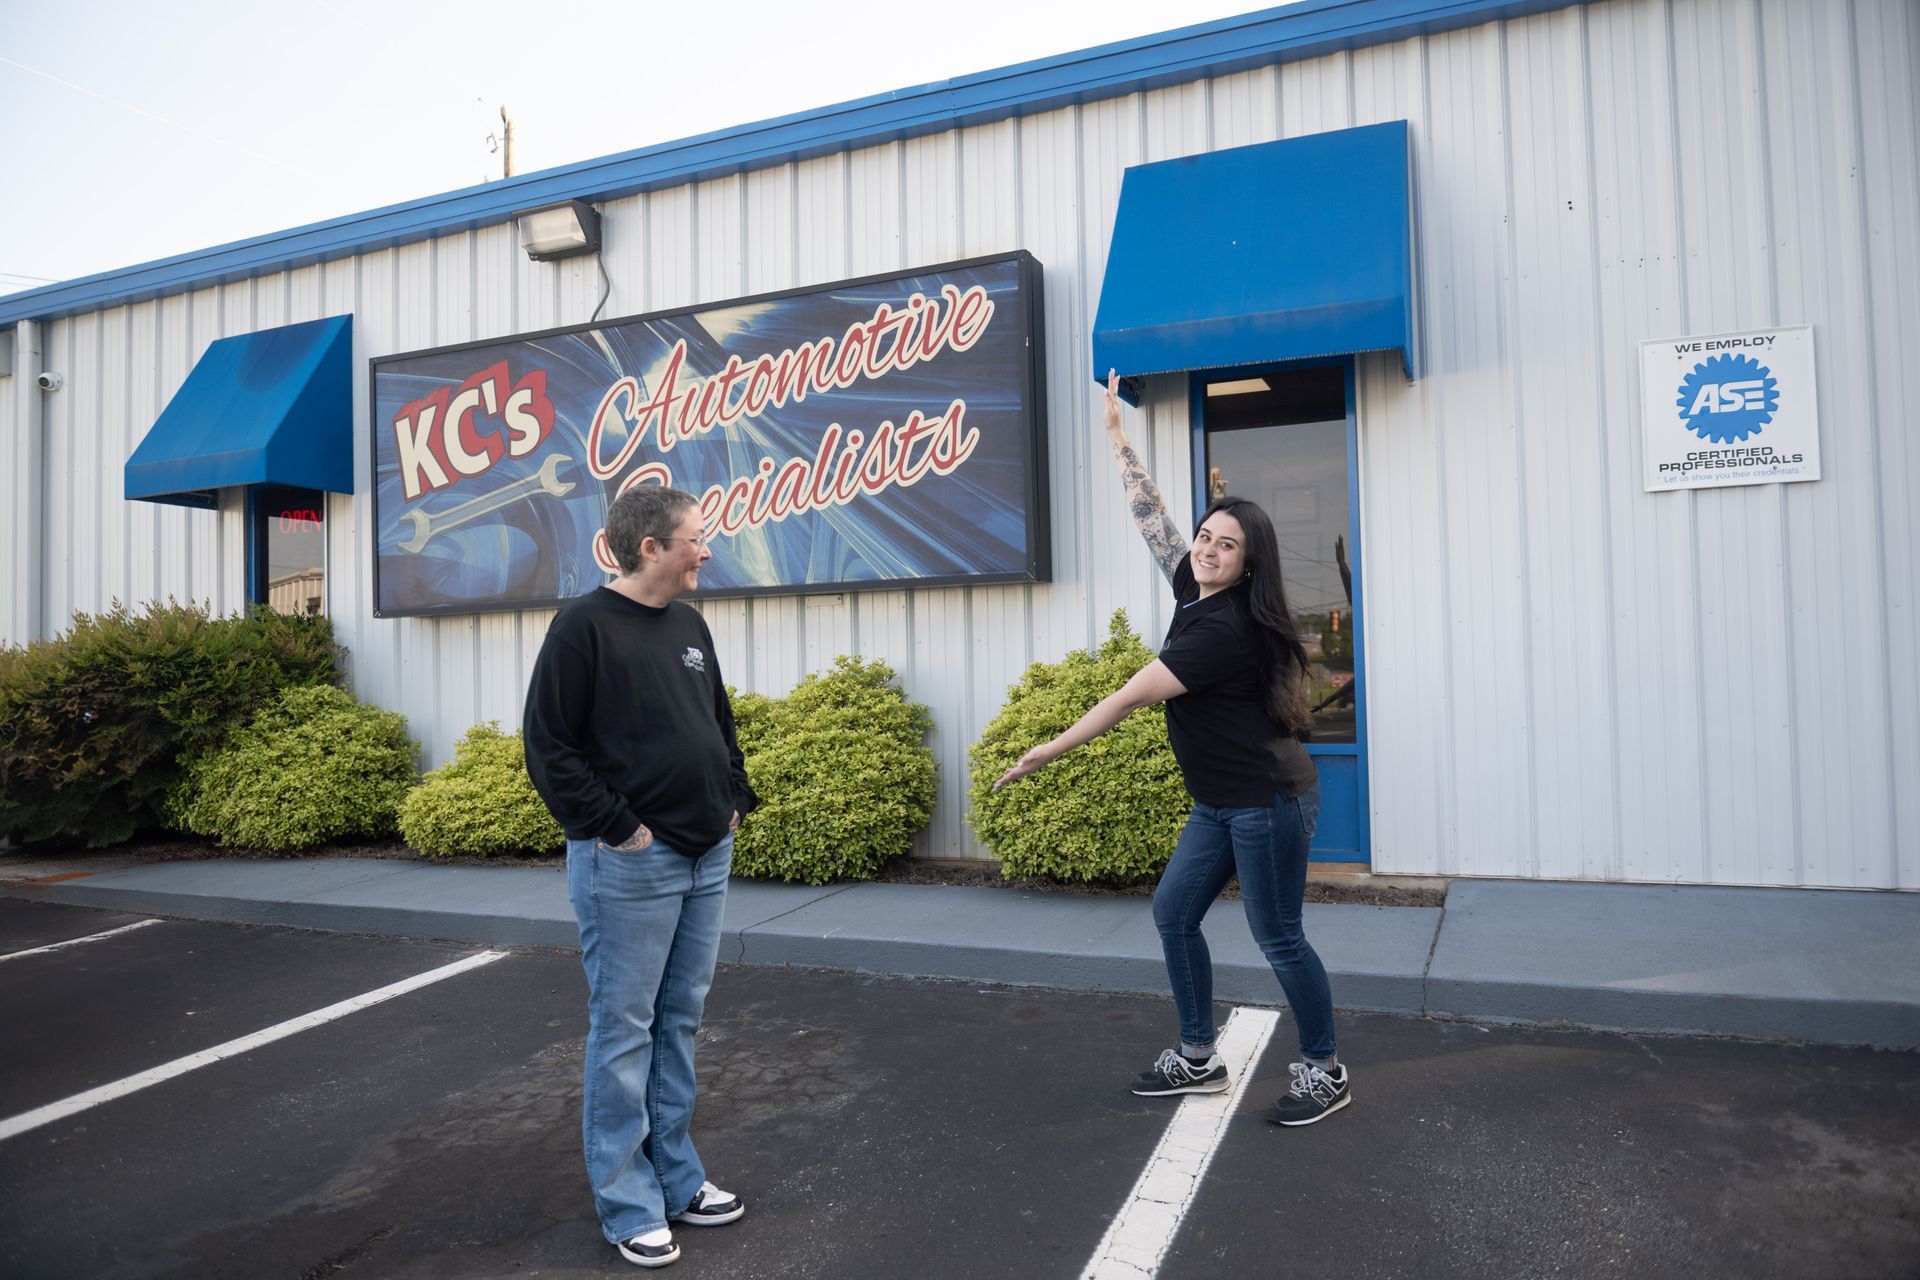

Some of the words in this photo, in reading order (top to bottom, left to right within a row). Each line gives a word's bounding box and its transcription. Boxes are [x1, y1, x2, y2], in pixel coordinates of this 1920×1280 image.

[1675, 343, 1702, 353] WE
[1706, 335, 1776, 350] EMPLOY
[587, 283, 995, 480] Automotive
[1688, 379, 1765, 416] ASE
[393, 376, 545, 502] KC's
[1659, 453, 1803, 472] PROFESSIONALS
[1686, 446, 1773, 461] CERTIFIED
[592, 398, 980, 576] Secialists
[1664, 475, 1677, 483] Let
[1691, 473, 1713, 482] show
[1715, 472, 1730, 481] you
[1732, 469, 1751, 478] their
[1753, 467, 1799, 477] credentials
[280, 509, 322, 534] OPEN
